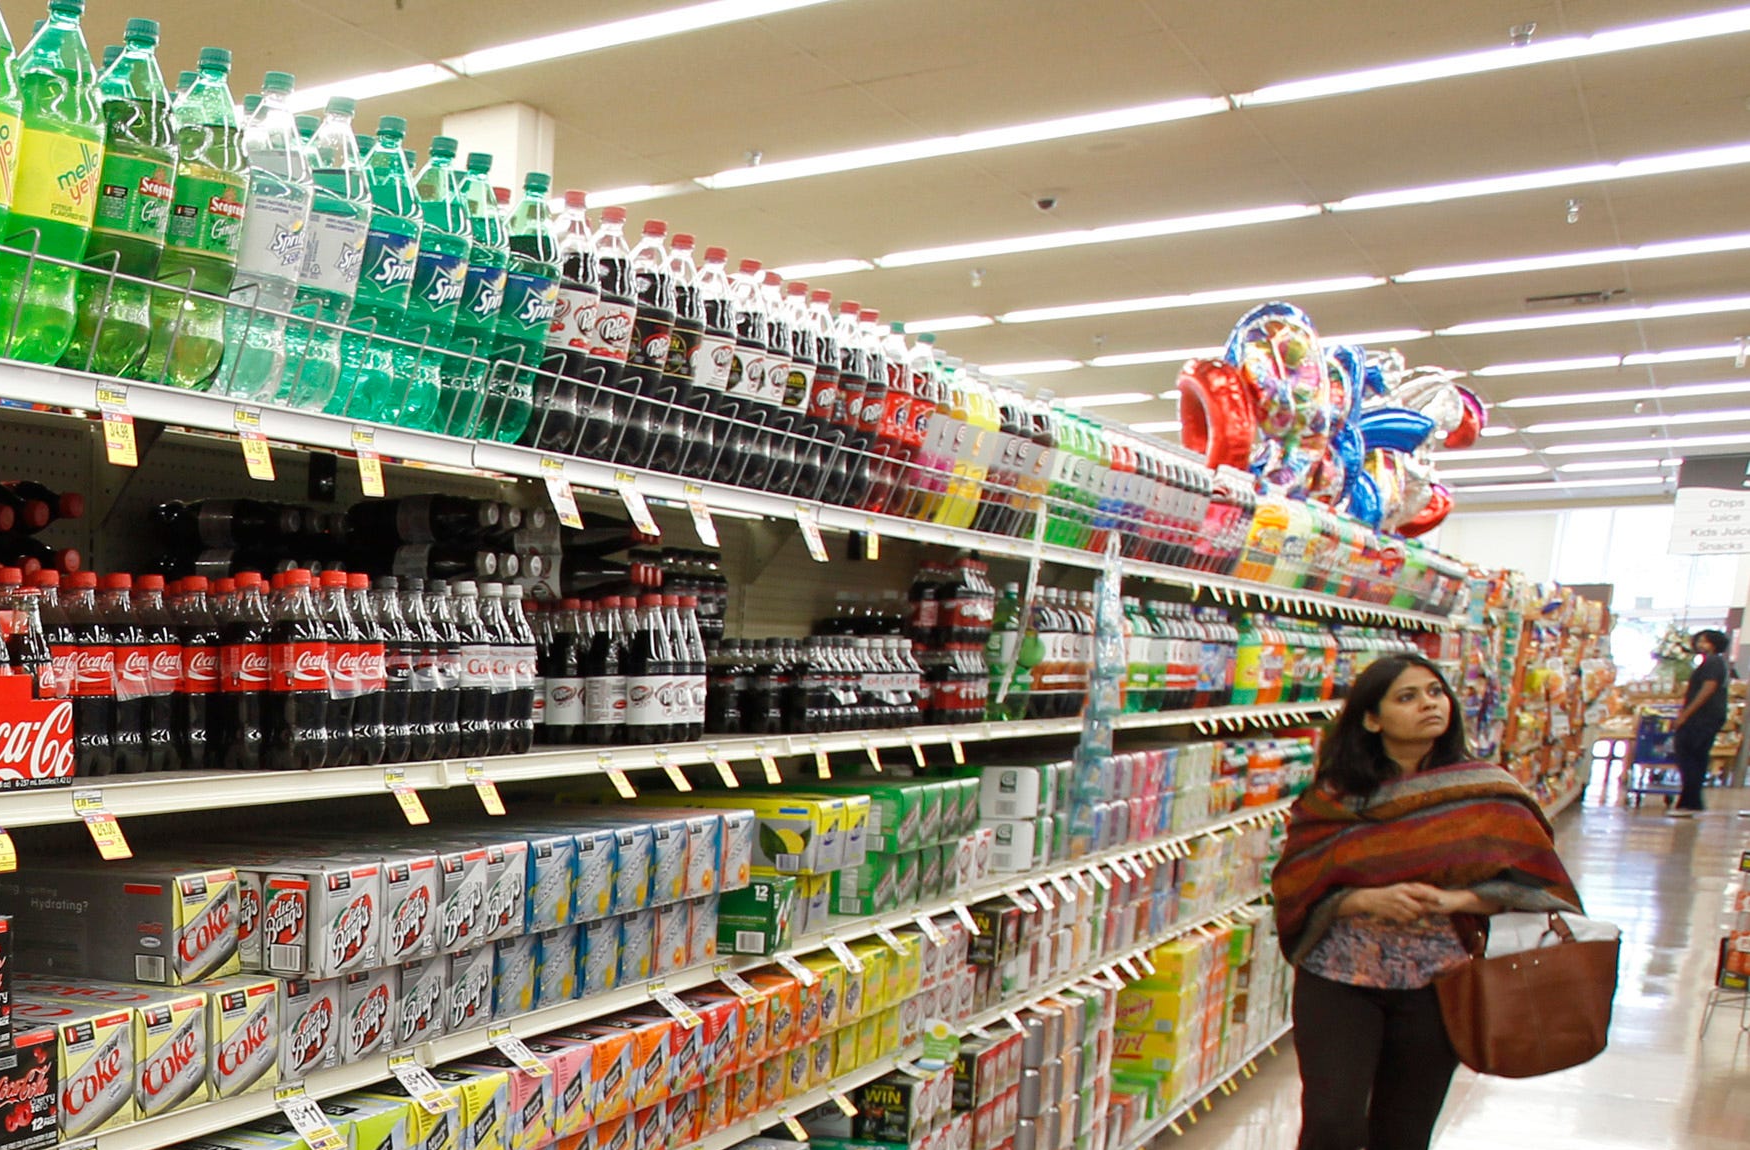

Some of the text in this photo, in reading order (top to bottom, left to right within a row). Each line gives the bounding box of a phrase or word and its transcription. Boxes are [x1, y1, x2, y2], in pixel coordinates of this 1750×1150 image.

[1708, 498, 1745, 509] Chips
[1707, 514, 1741, 523] Juice
[1690, 527, 1718, 537] Kids
[1697, 542, 1744, 552] Snacks
[754, 885, 768, 897] 12
[63, 1048, 121, 1115] Coke
[865, 1089, 902, 1105] WIN
